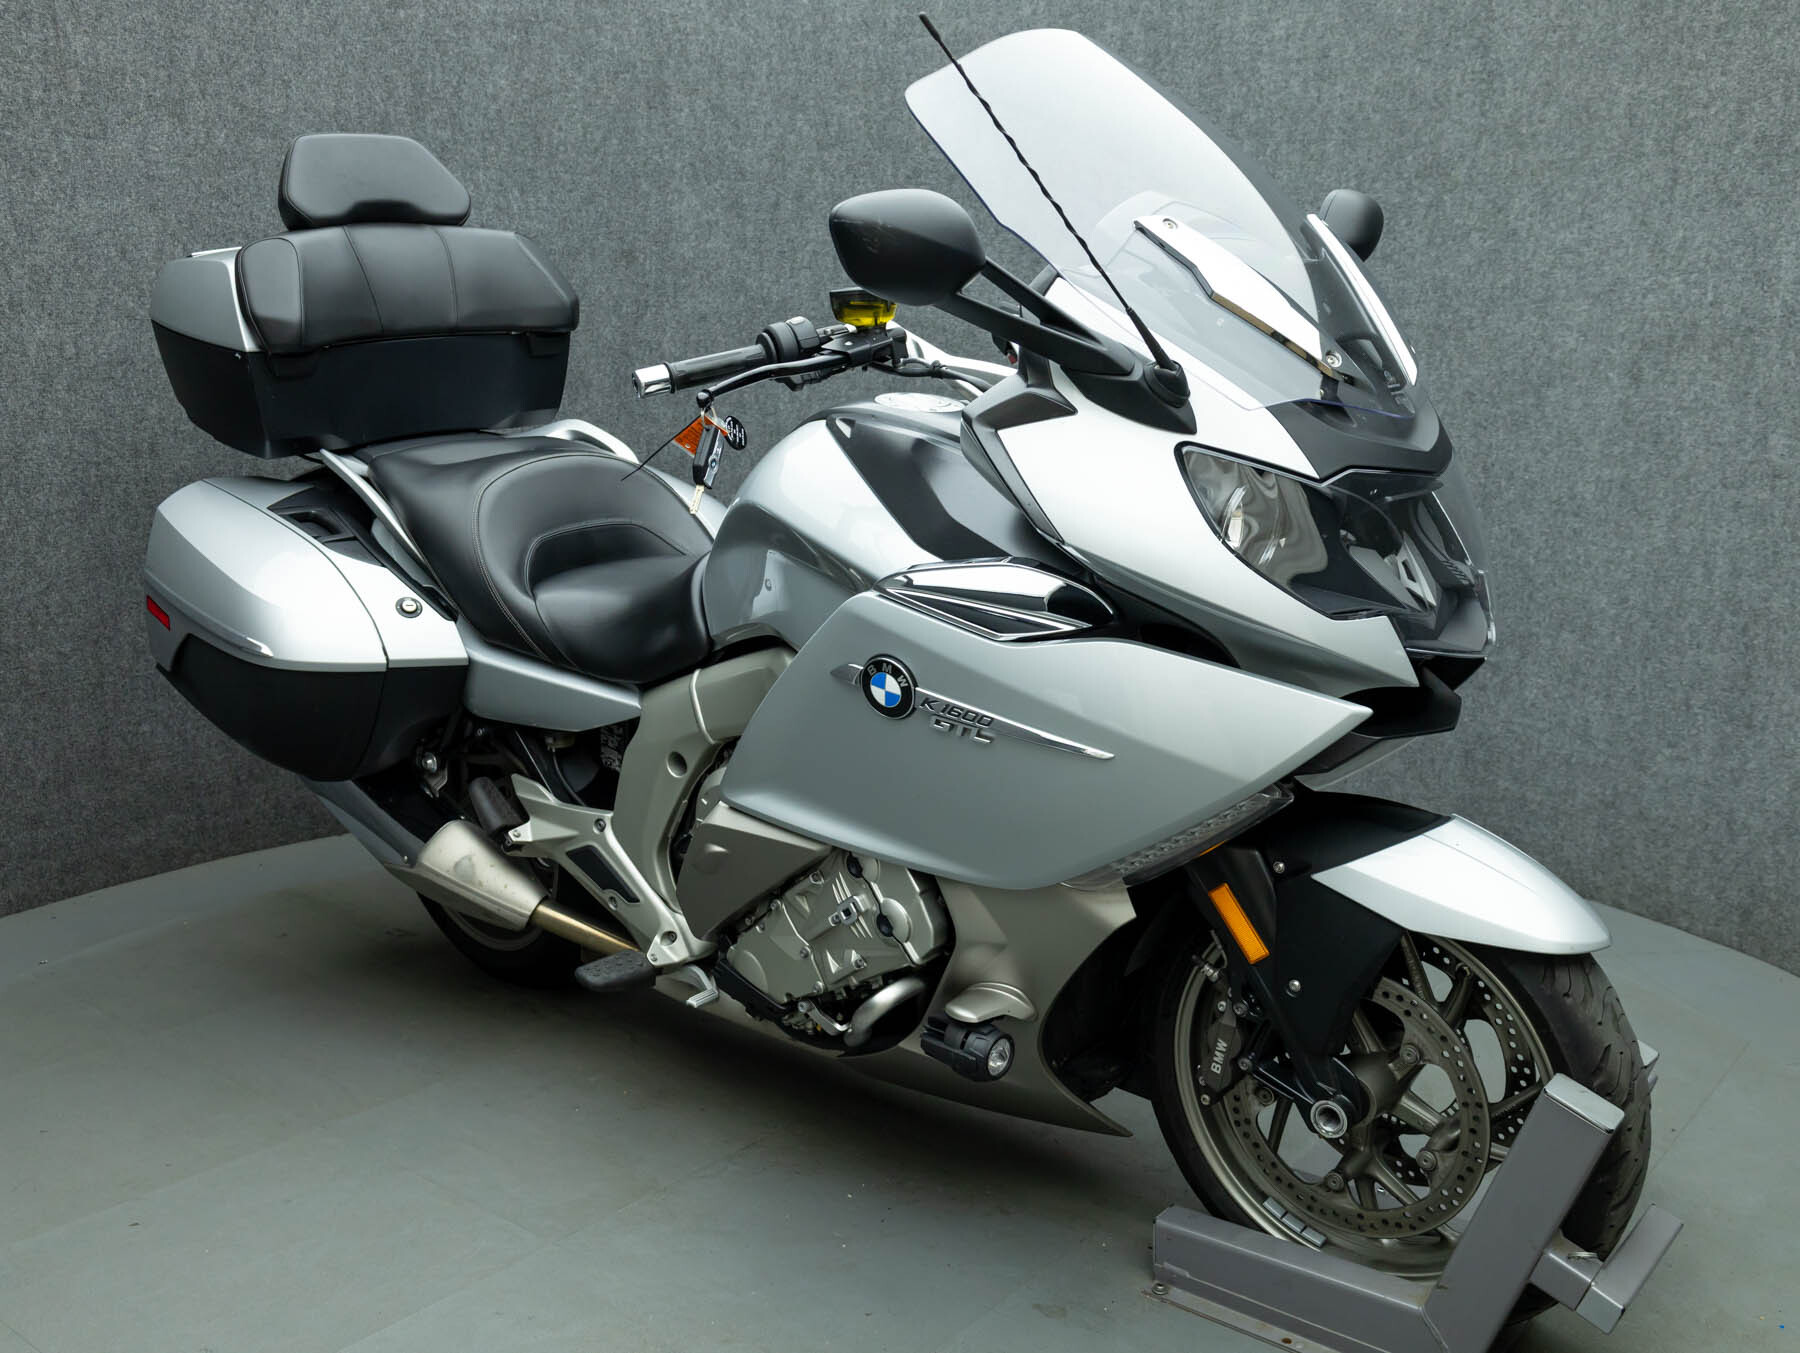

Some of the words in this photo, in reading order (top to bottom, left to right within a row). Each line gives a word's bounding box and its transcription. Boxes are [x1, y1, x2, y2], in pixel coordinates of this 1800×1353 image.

[866, 662, 909, 689] BMW
[930, 715, 998, 743] GTL
[1210, 1037, 1228, 1074] BMW
